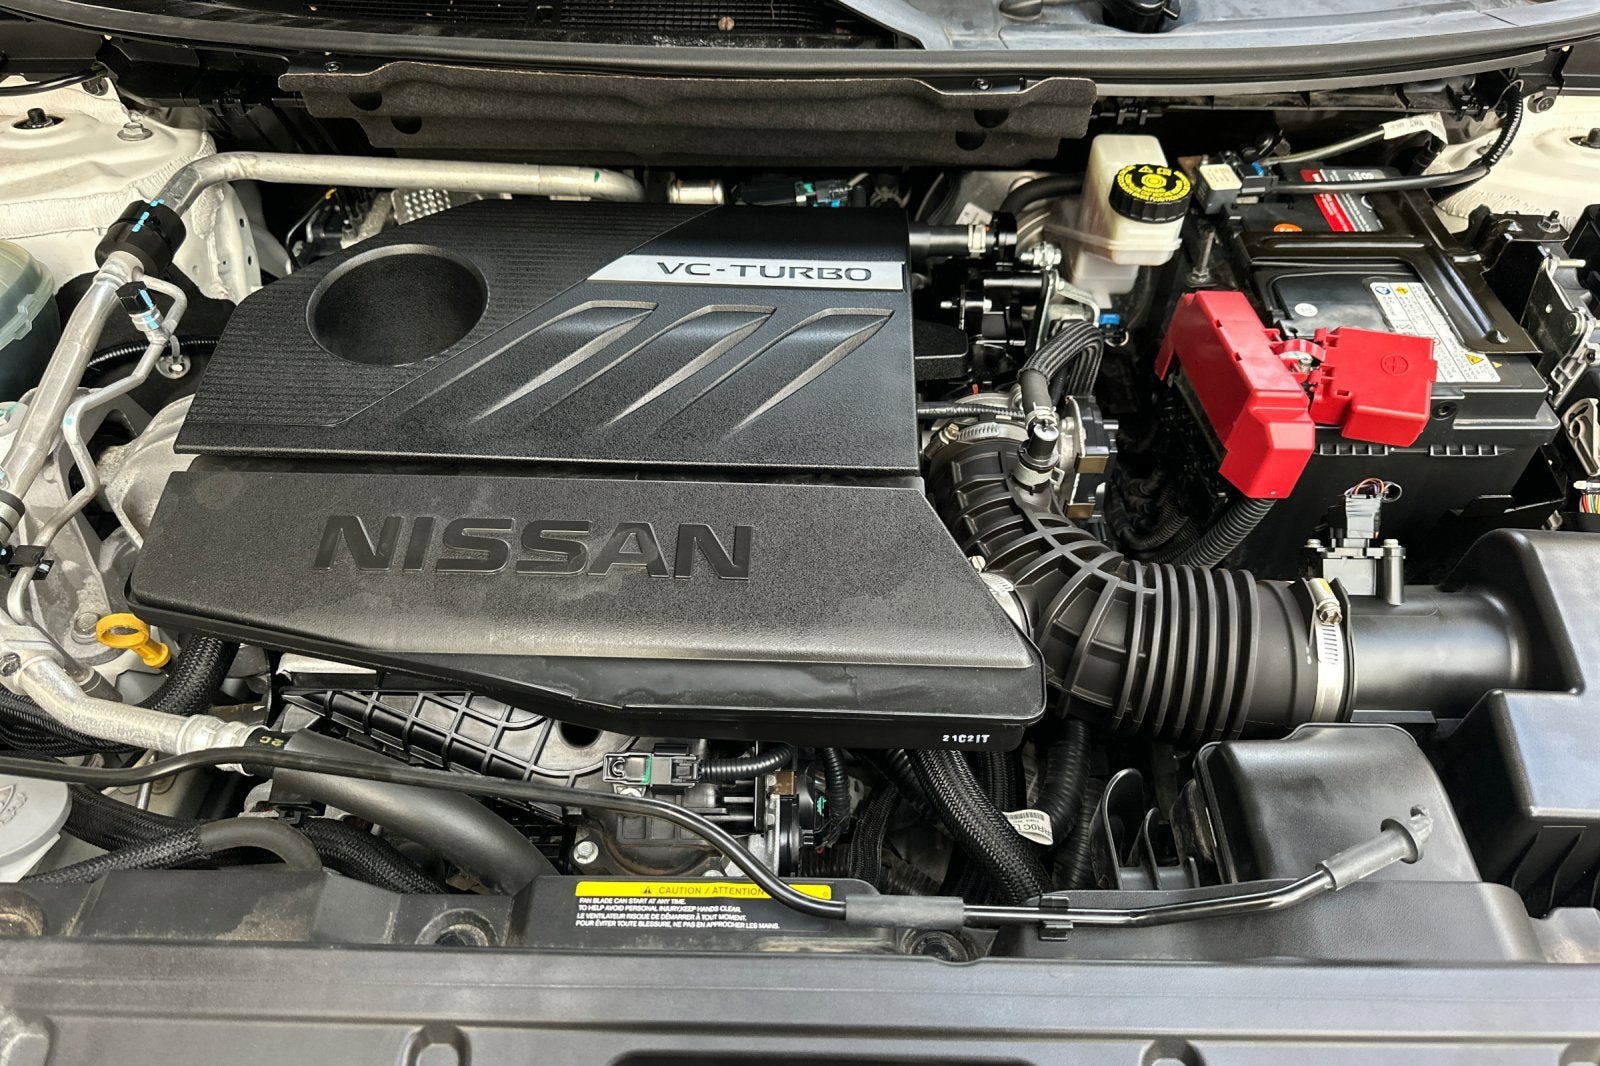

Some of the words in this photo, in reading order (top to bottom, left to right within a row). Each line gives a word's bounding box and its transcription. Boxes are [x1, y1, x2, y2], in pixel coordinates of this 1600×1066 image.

[656, 261, 872, 282] VC-TURBO
[313, 515, 754, 580] NISSAN
[658, 886, 701, 895] CAUTION
[711, 886, 765, 896] ATTENTION
[660, 912, 695, 920] DÉMARRER
[575, 919, 595, 927] POUR
[595, 919, 616, 927] ÉVITER
